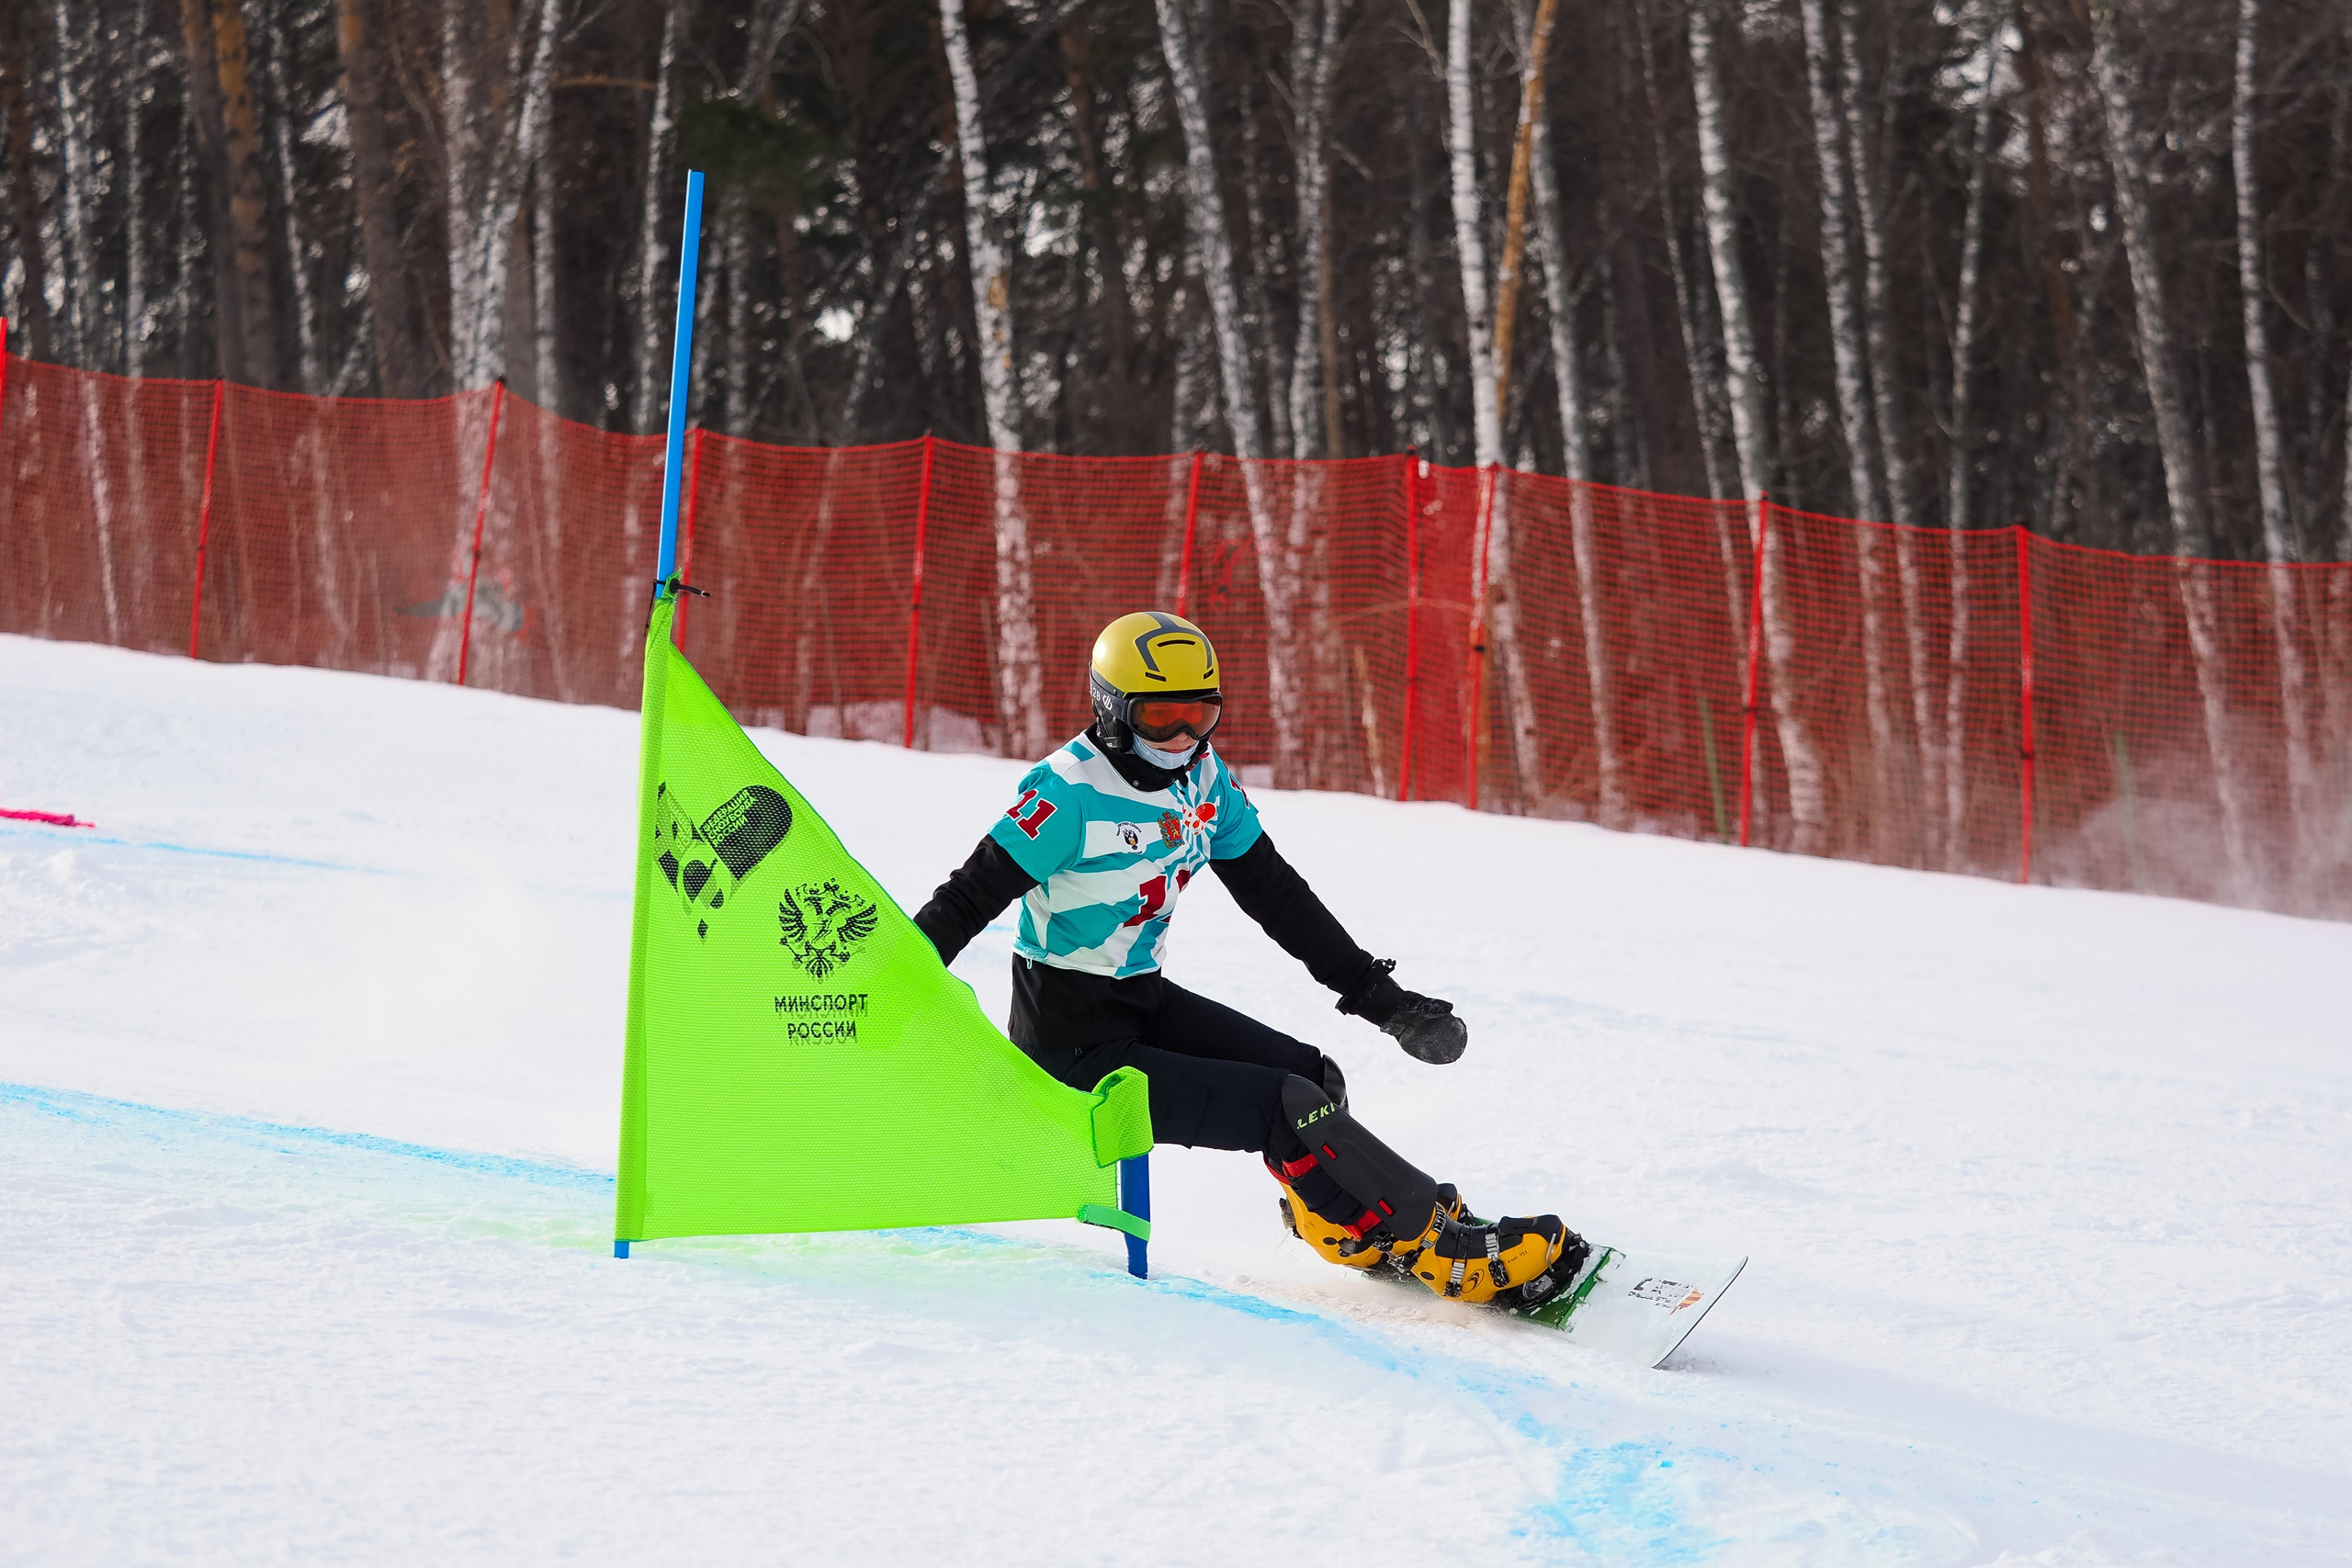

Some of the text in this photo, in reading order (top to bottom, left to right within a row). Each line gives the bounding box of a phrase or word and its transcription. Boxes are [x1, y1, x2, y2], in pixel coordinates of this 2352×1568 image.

[703, 789, 752, 832] ФЕДЕРАЦИЯ
[707, 796, 758, 840] СНОУБОРДА
[1006, 789, 1057, 840] 11
[712, 815, 749, 847] РОССИИ
[774, 993, 868, 1012] МИНСПОРТ
[787, 1020, 856, 1040] РОССИИ
[1296, 1102, 1336, 1130] LEKI
